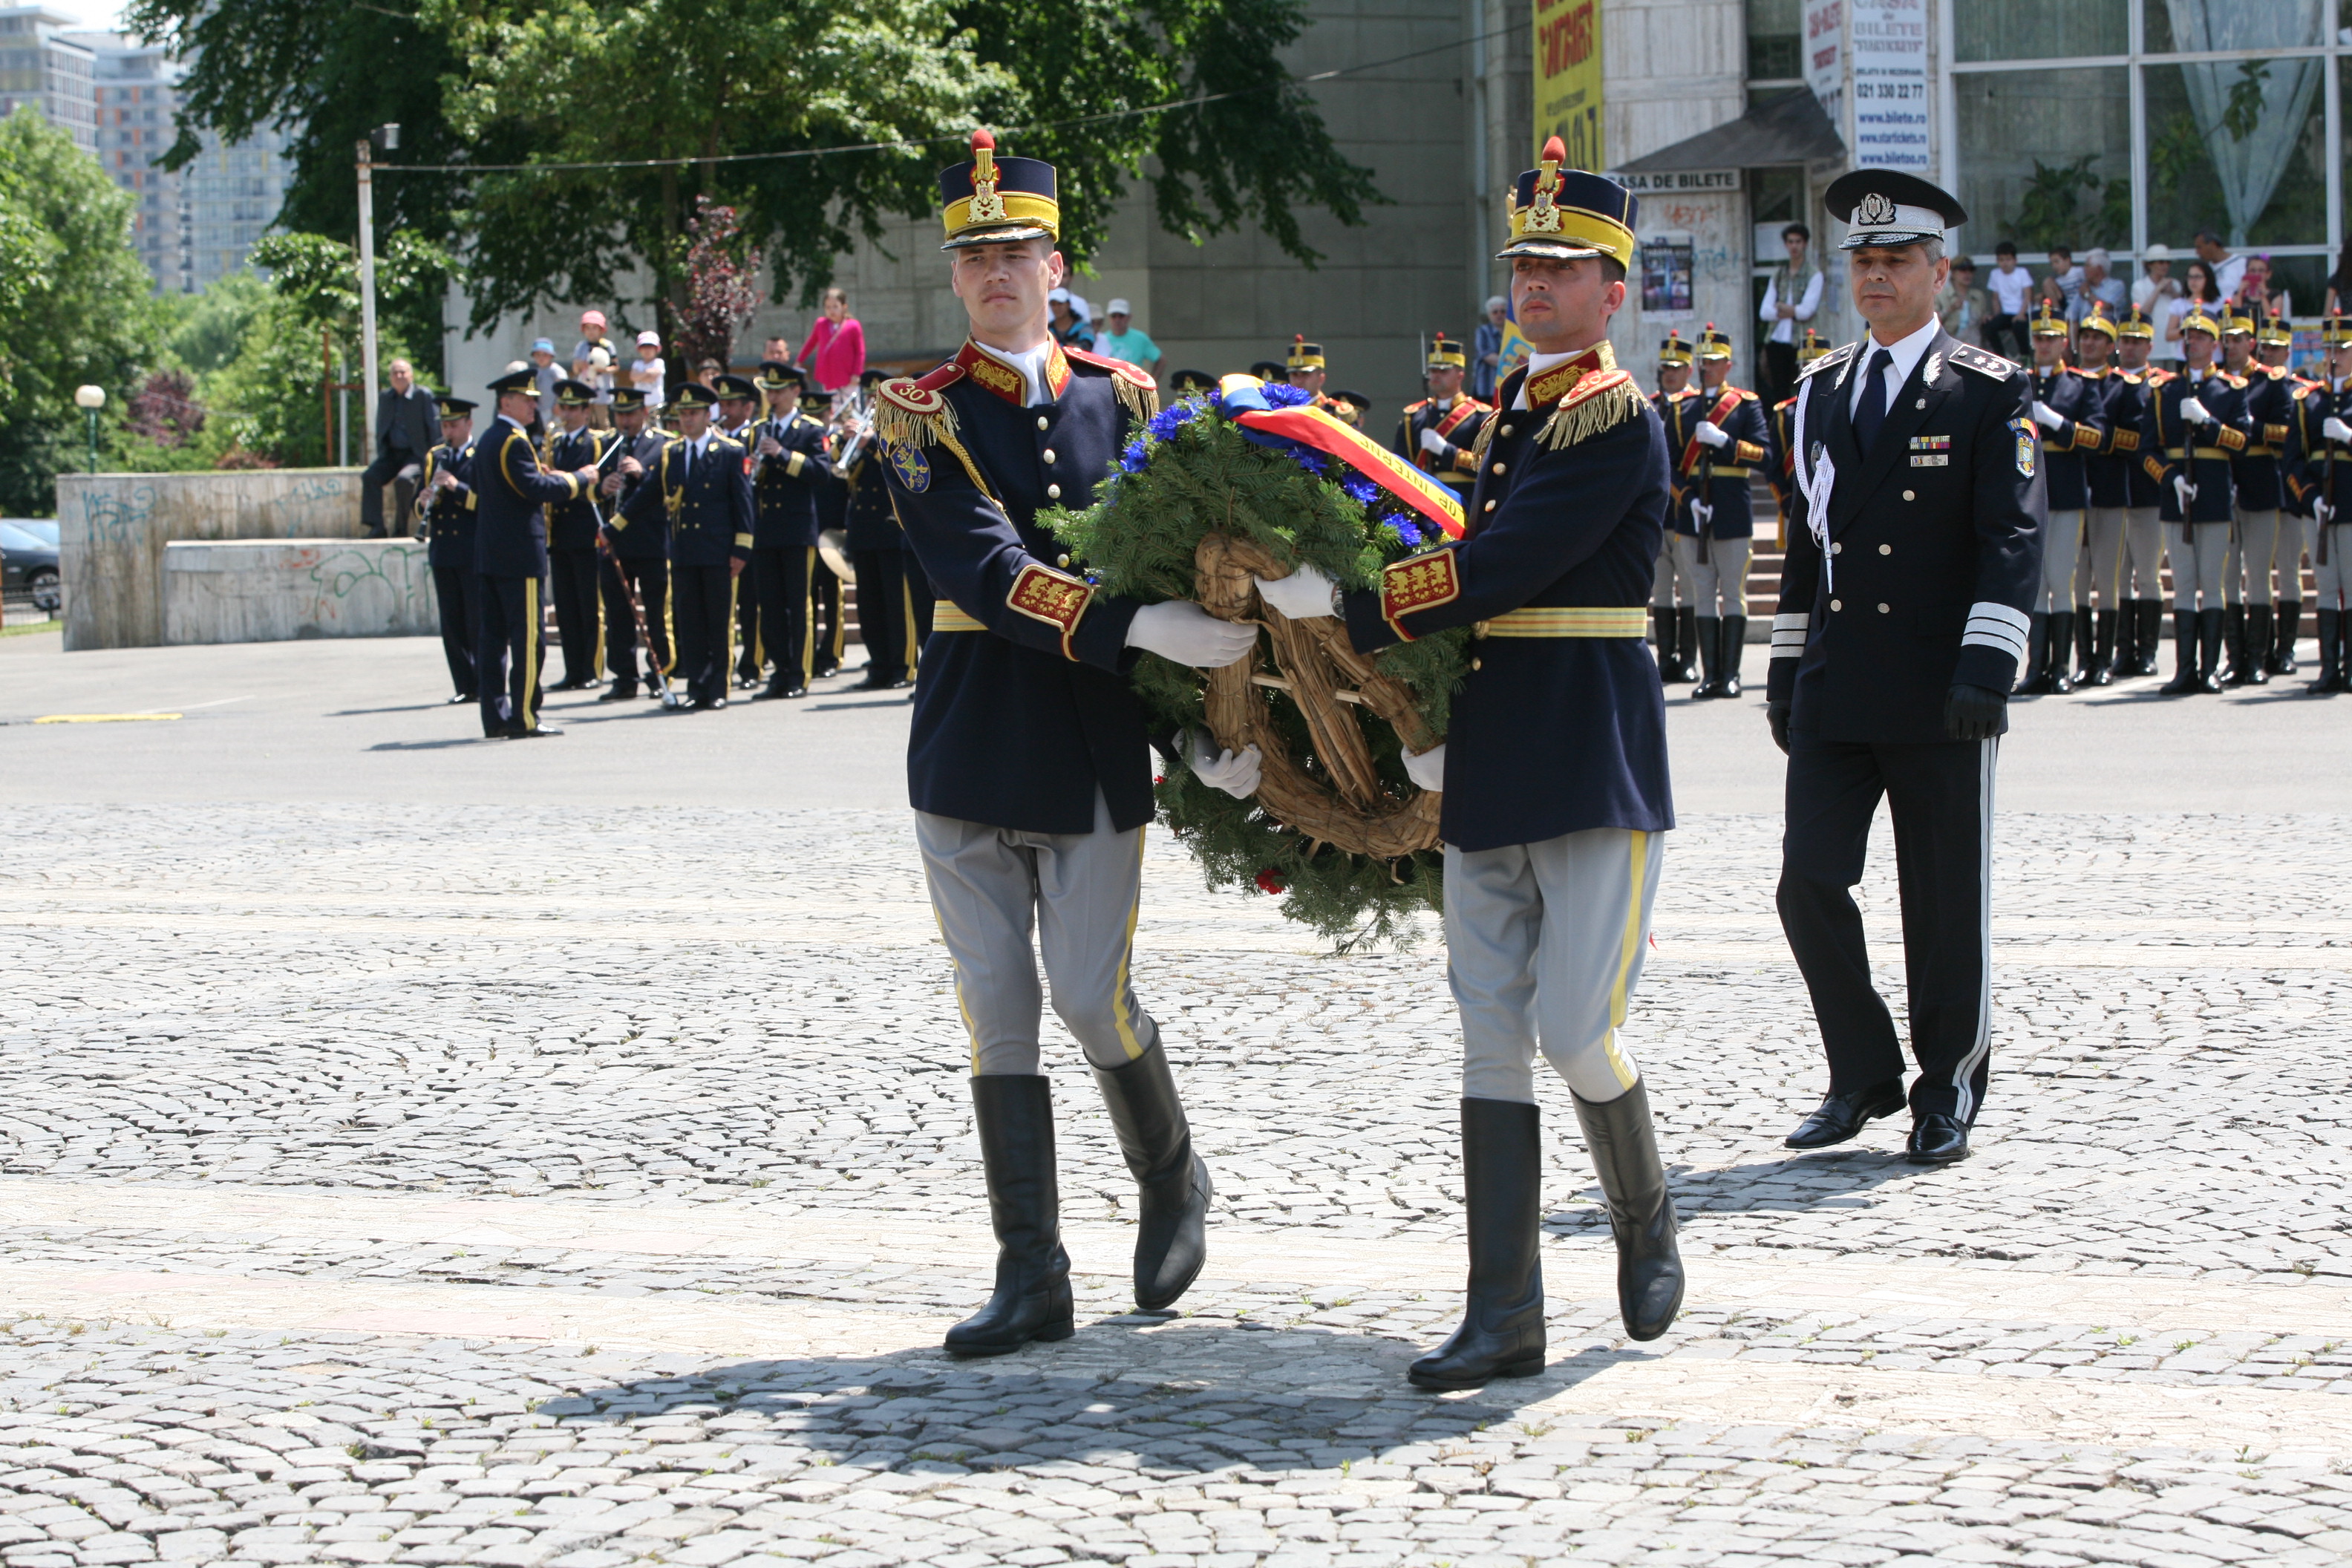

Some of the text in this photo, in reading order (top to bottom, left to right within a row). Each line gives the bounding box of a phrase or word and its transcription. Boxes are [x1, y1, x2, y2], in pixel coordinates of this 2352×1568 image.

[1855, 22, 1922, 36] BILETE
[1857, 83, 1923, 99] 021 330 22 77
[1858, 110, 1926, 124] www.bilete.ro
[1653, 174, 1674, 188] DE
[1679, 172, 1734, 187] BILETE
[1577, 374, 1603, 393] 30
[898, 384, 926, 402] 30
[1359, 434, 1428, 494] INTERNE
[915, 474, 926, 488] 30
